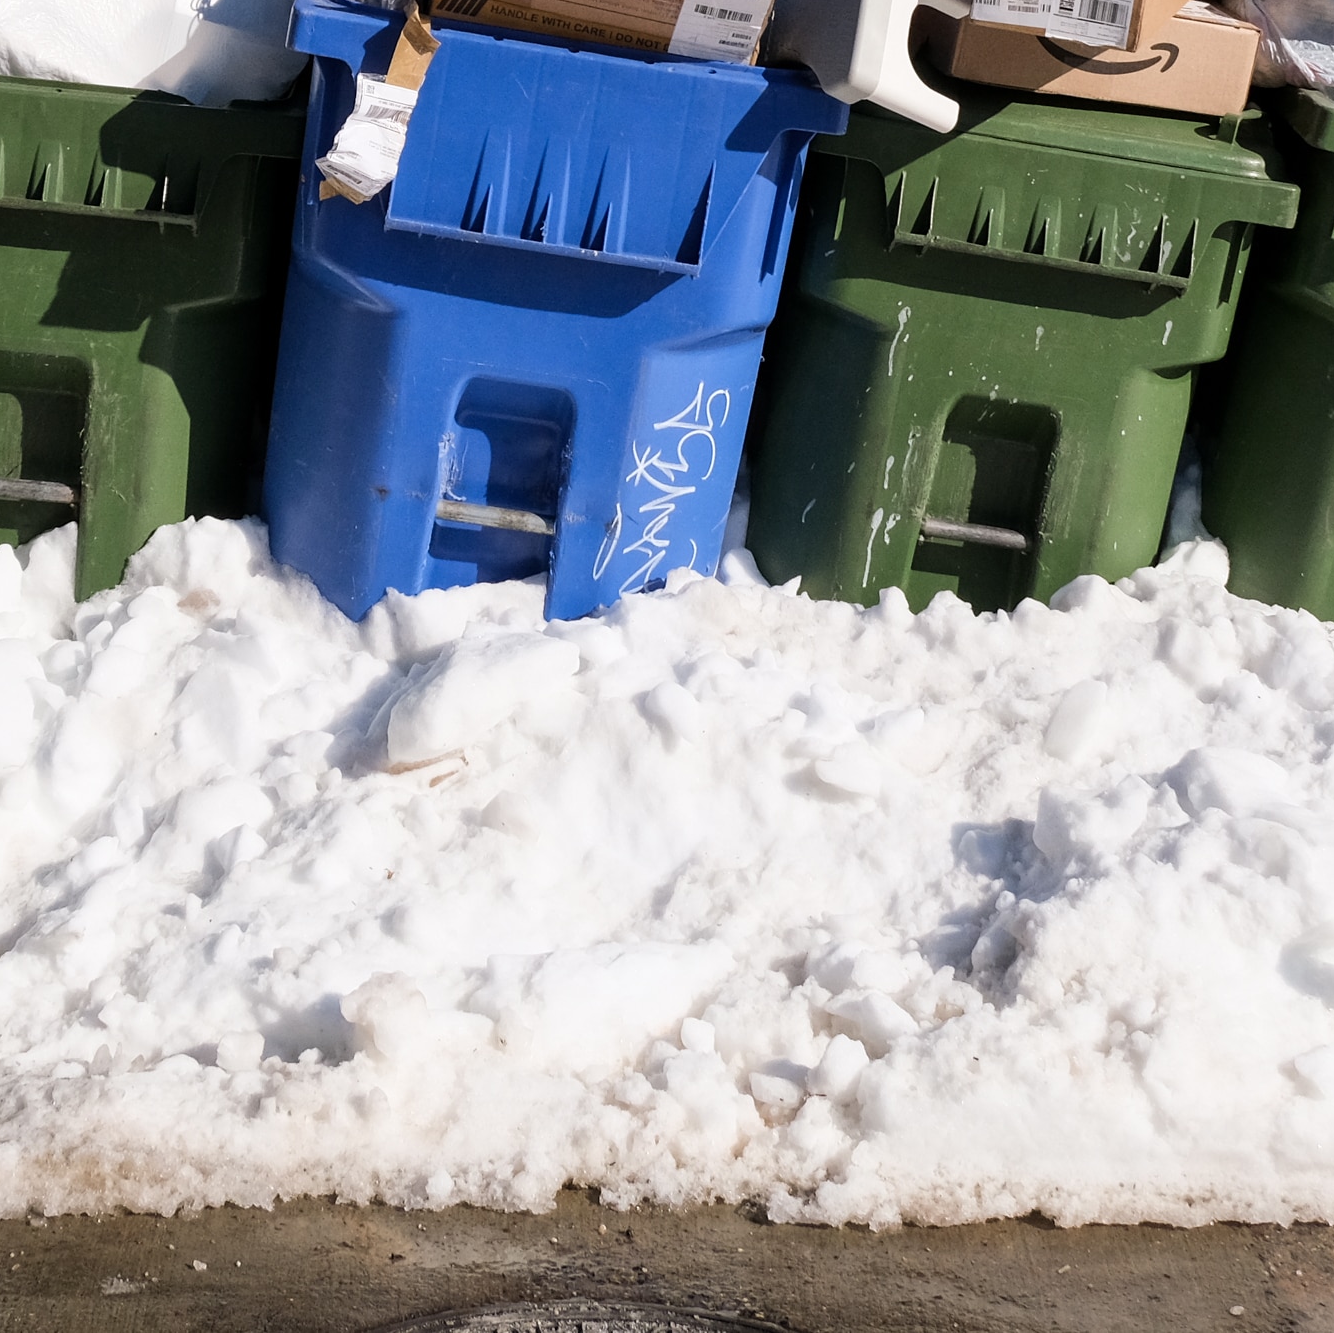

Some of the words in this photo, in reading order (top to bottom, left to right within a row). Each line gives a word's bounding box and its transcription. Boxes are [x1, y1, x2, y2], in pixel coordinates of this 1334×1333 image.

[490, 5, 538, 23] HANDLE
[542, 16, 571, 30] WITH
[573, 23, 606, 37] CARE
[616, 33, 635, 45] DO
[636, 37, 660, 50] NOT
